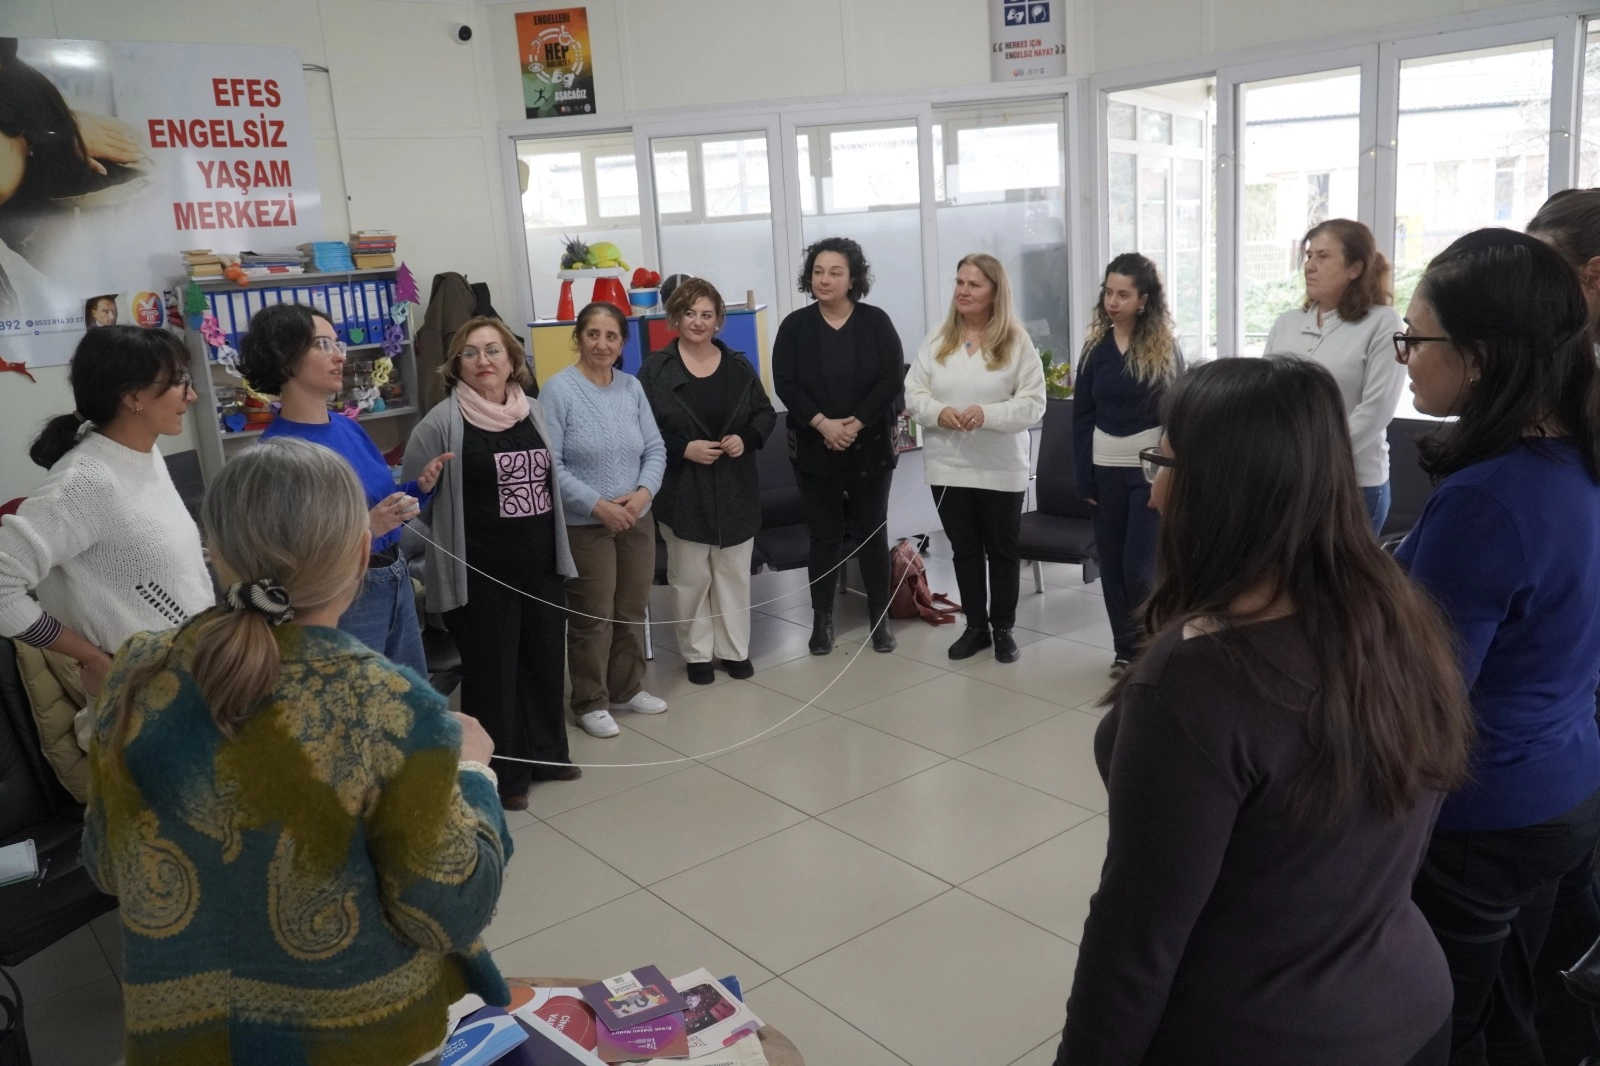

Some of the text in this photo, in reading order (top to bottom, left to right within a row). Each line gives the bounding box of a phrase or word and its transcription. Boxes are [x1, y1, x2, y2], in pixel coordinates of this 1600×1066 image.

[544, 43, 569, 60] HEP
[1005, 40, 1028, 49] HERKES
[1033, 48, 1054, 57] HAYAT
[212, 77, 281, 107] EFES
[554, 89, 587, 102] AŞACAĞIZ
[148, 113, 287, 148] ENGELSİZ
[196, 160, 292, 195] YAŞAM
[173, 192, 297, 230] MERKEZİ
[556, 1015, 570, 1032] CİNS
